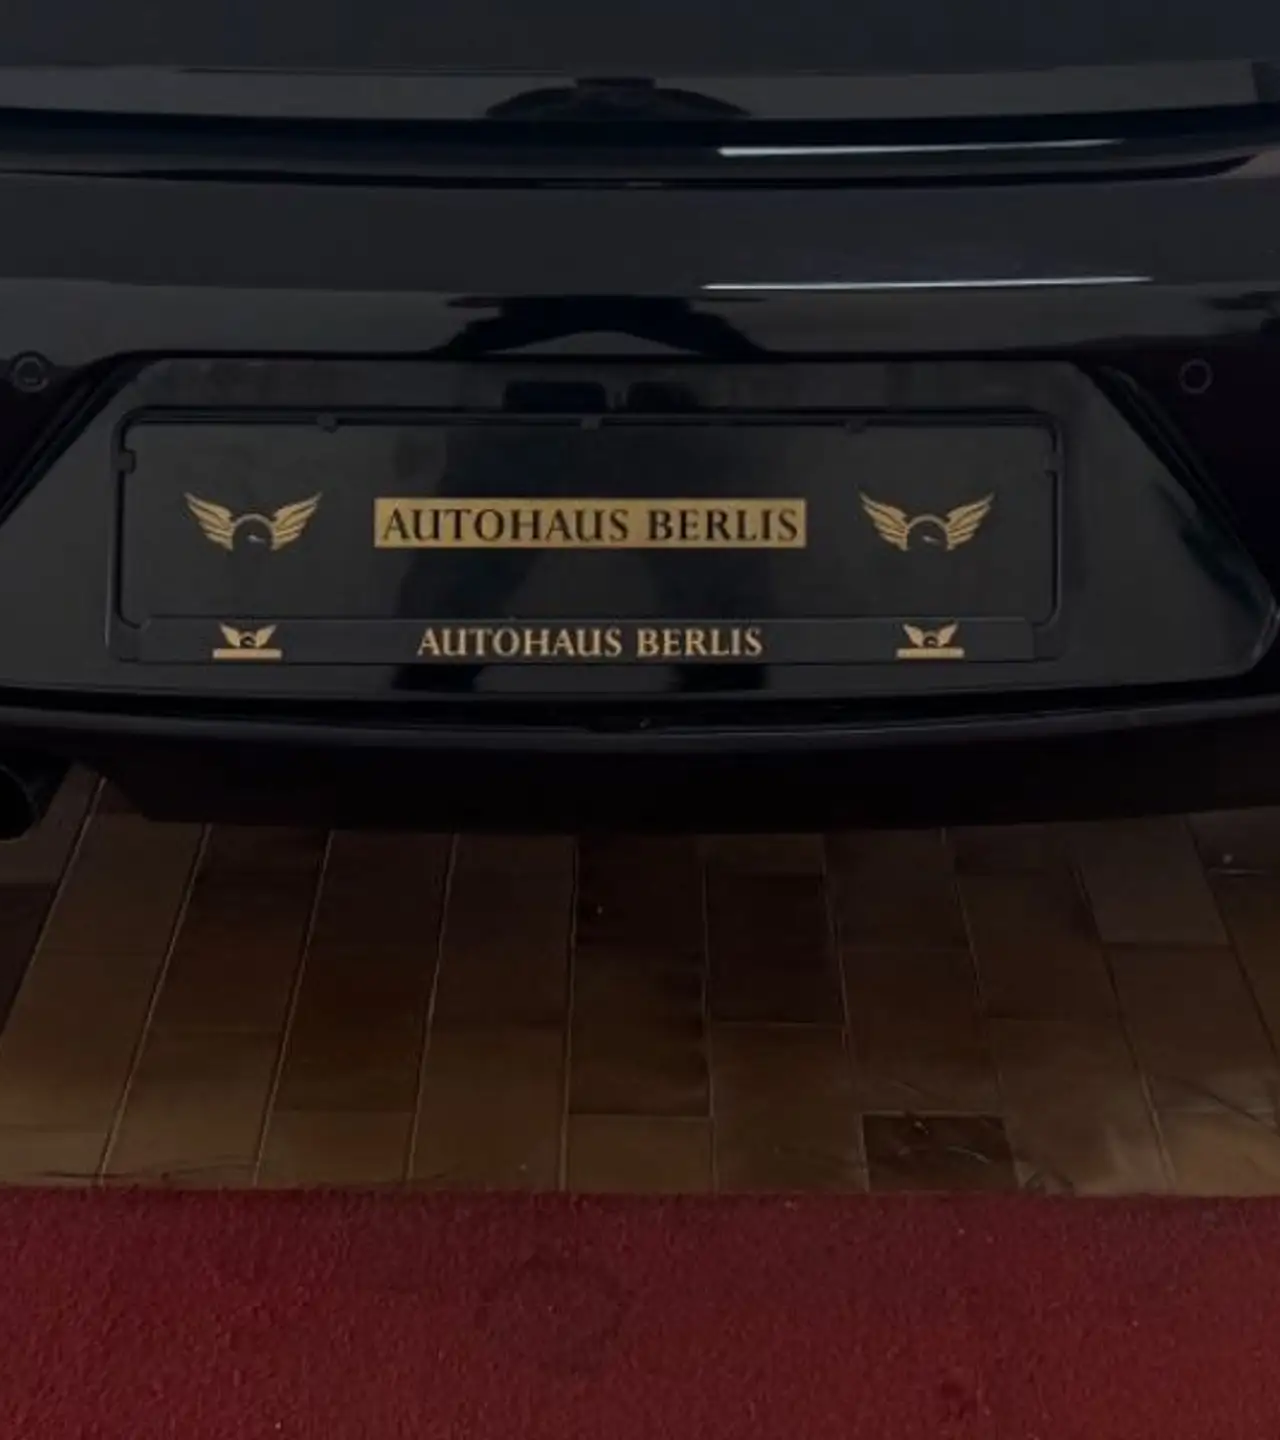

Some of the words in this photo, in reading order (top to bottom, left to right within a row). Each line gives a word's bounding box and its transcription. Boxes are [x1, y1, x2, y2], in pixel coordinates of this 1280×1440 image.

[382, 508, 630, 542] AUTOHAUS
[645, 508, 799, 542] BERLIS
[417, 627, 623, 656] AUTOHAUS
[636, 627, 763, 656] BERLIS
